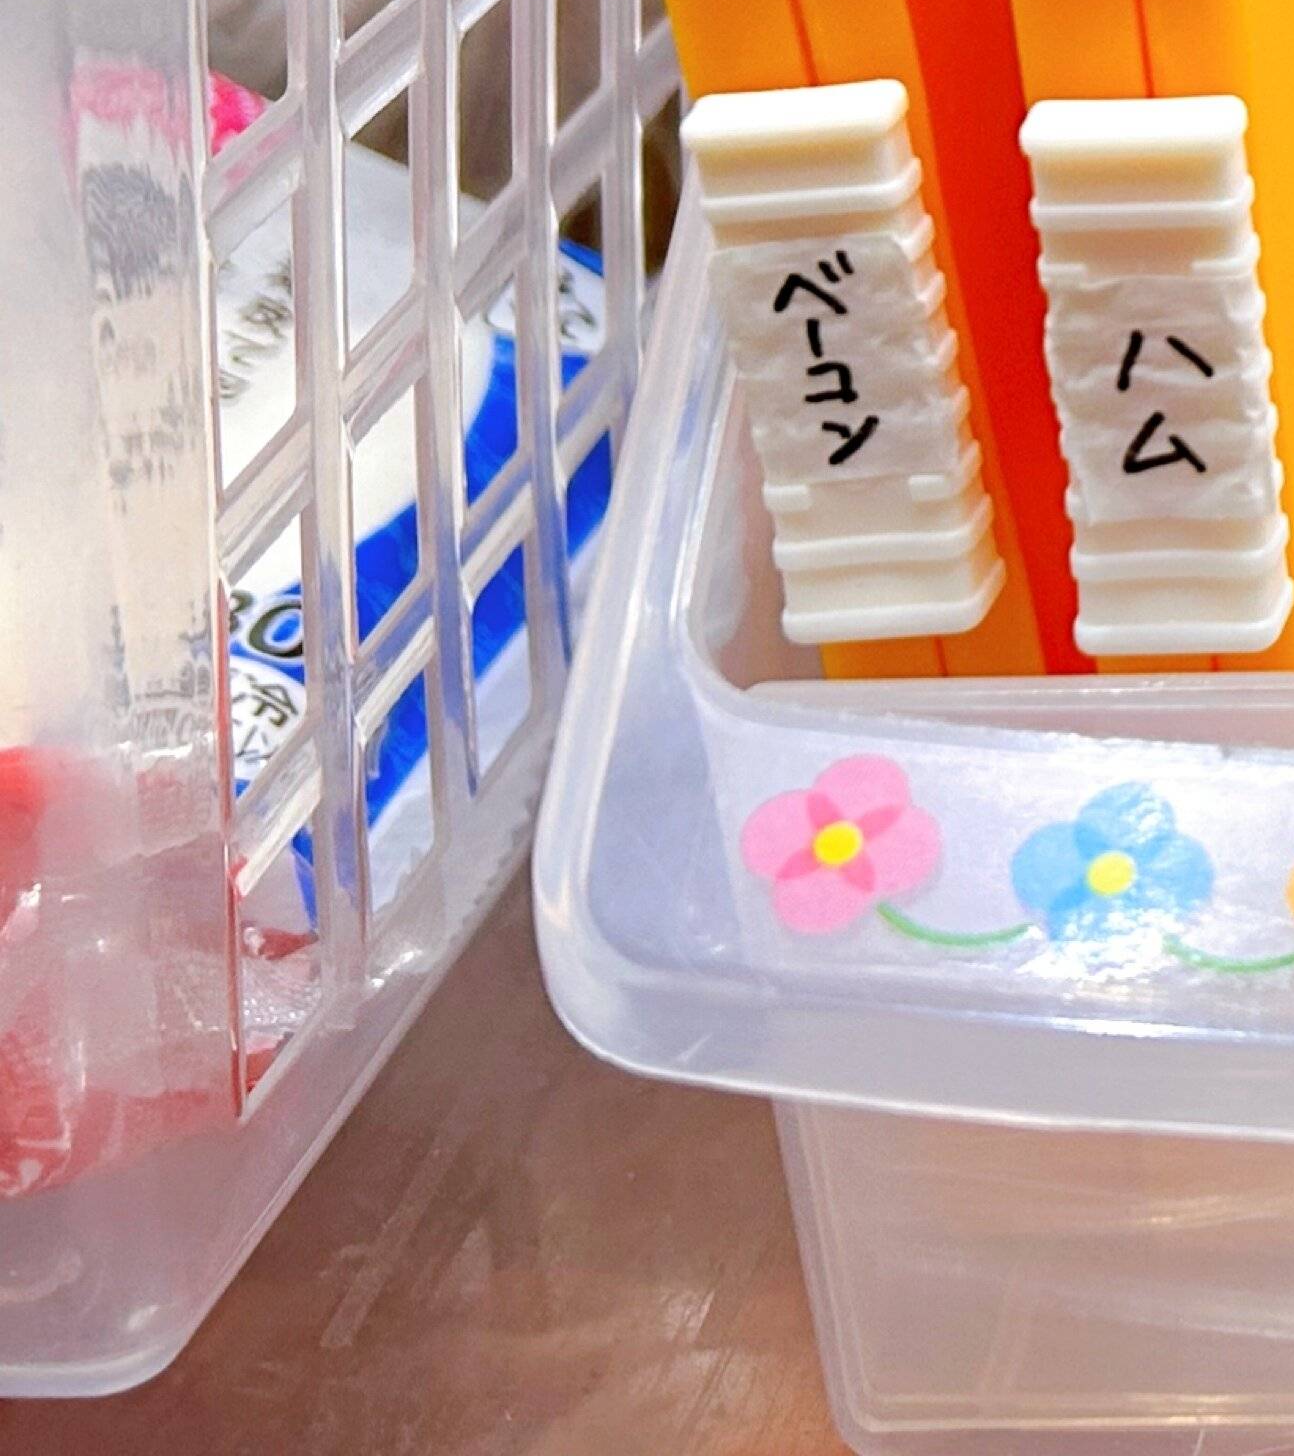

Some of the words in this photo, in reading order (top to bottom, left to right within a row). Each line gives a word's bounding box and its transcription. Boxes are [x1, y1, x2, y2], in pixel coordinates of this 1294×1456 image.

[773, 249, 880, 467] ベーコン
[1116, 329, 1214, 475] ハム
